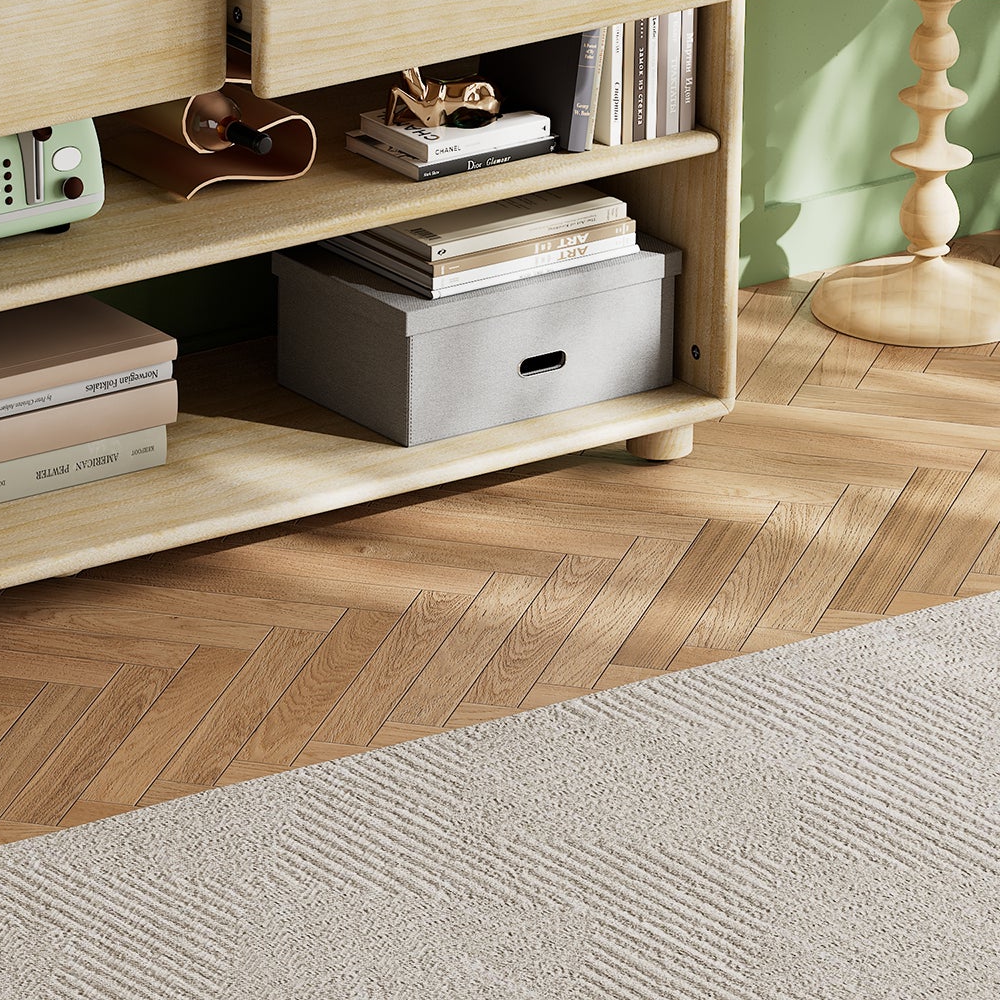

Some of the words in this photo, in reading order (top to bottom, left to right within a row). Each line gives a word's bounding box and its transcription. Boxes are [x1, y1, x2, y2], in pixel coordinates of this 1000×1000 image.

[685, 32, 694, 73] Мартин
[684, 77, 693, 105] Иден
[637, 93, 645, 125] стекла
[434, 145, 462, 155] CHANEL
[467, 159, 483, 171] Dior
[486, 155, 512, 167] Glamour
[556, 232, 590, 249] ART
[557, 246, 589, 261] ART
[85, 377, 118, 393] Folktales
[119, 368, 159, 386] Norwegian
[46, 394, 53, 402] by
[74, 452, 120, 472] AMERICAN
[35, 464, 70, 480] PEWTER
